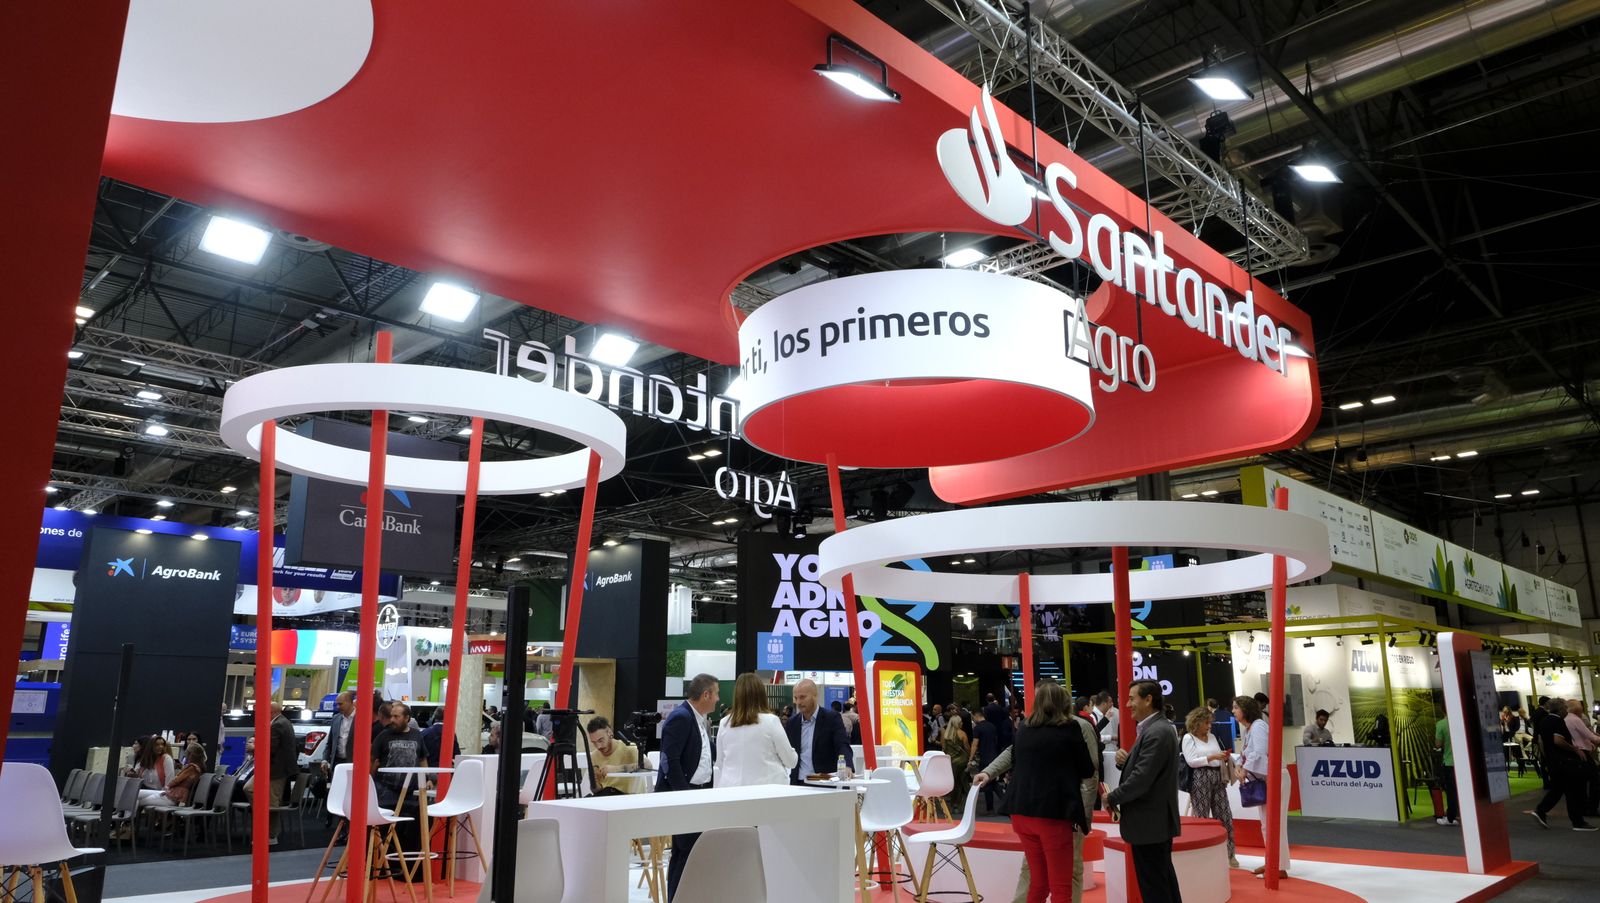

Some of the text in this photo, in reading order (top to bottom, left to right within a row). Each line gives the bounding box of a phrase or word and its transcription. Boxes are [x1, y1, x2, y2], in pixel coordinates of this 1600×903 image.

[1045, 162, 1287, 377] Santander
[752, 338, 767, 375] ti,
[773, 328, 810, 362] los
[820, 306, 991, 357] primeros
[1067, 298, 1156, 392] Agro
[339, 508, 422, 535] CaiBank
[67, 528, 83, 538] de
[152, 565, 221, 581] AgroBank
[595, 571, 633, 587] AgroBank
[771, 582, 846, 609] ADN
[771, 609, 882, 638] AGRO
[1351, 649, 1379, 673] AZUD
[1132, 665, 1158, 681] DN
[882, 689, 905, 697] NUESTRA
[1311, 759, 1381, 779] AZUD
[1349, 780, 1362, 788] del
[1363, 781, 1383, 789] Agua
